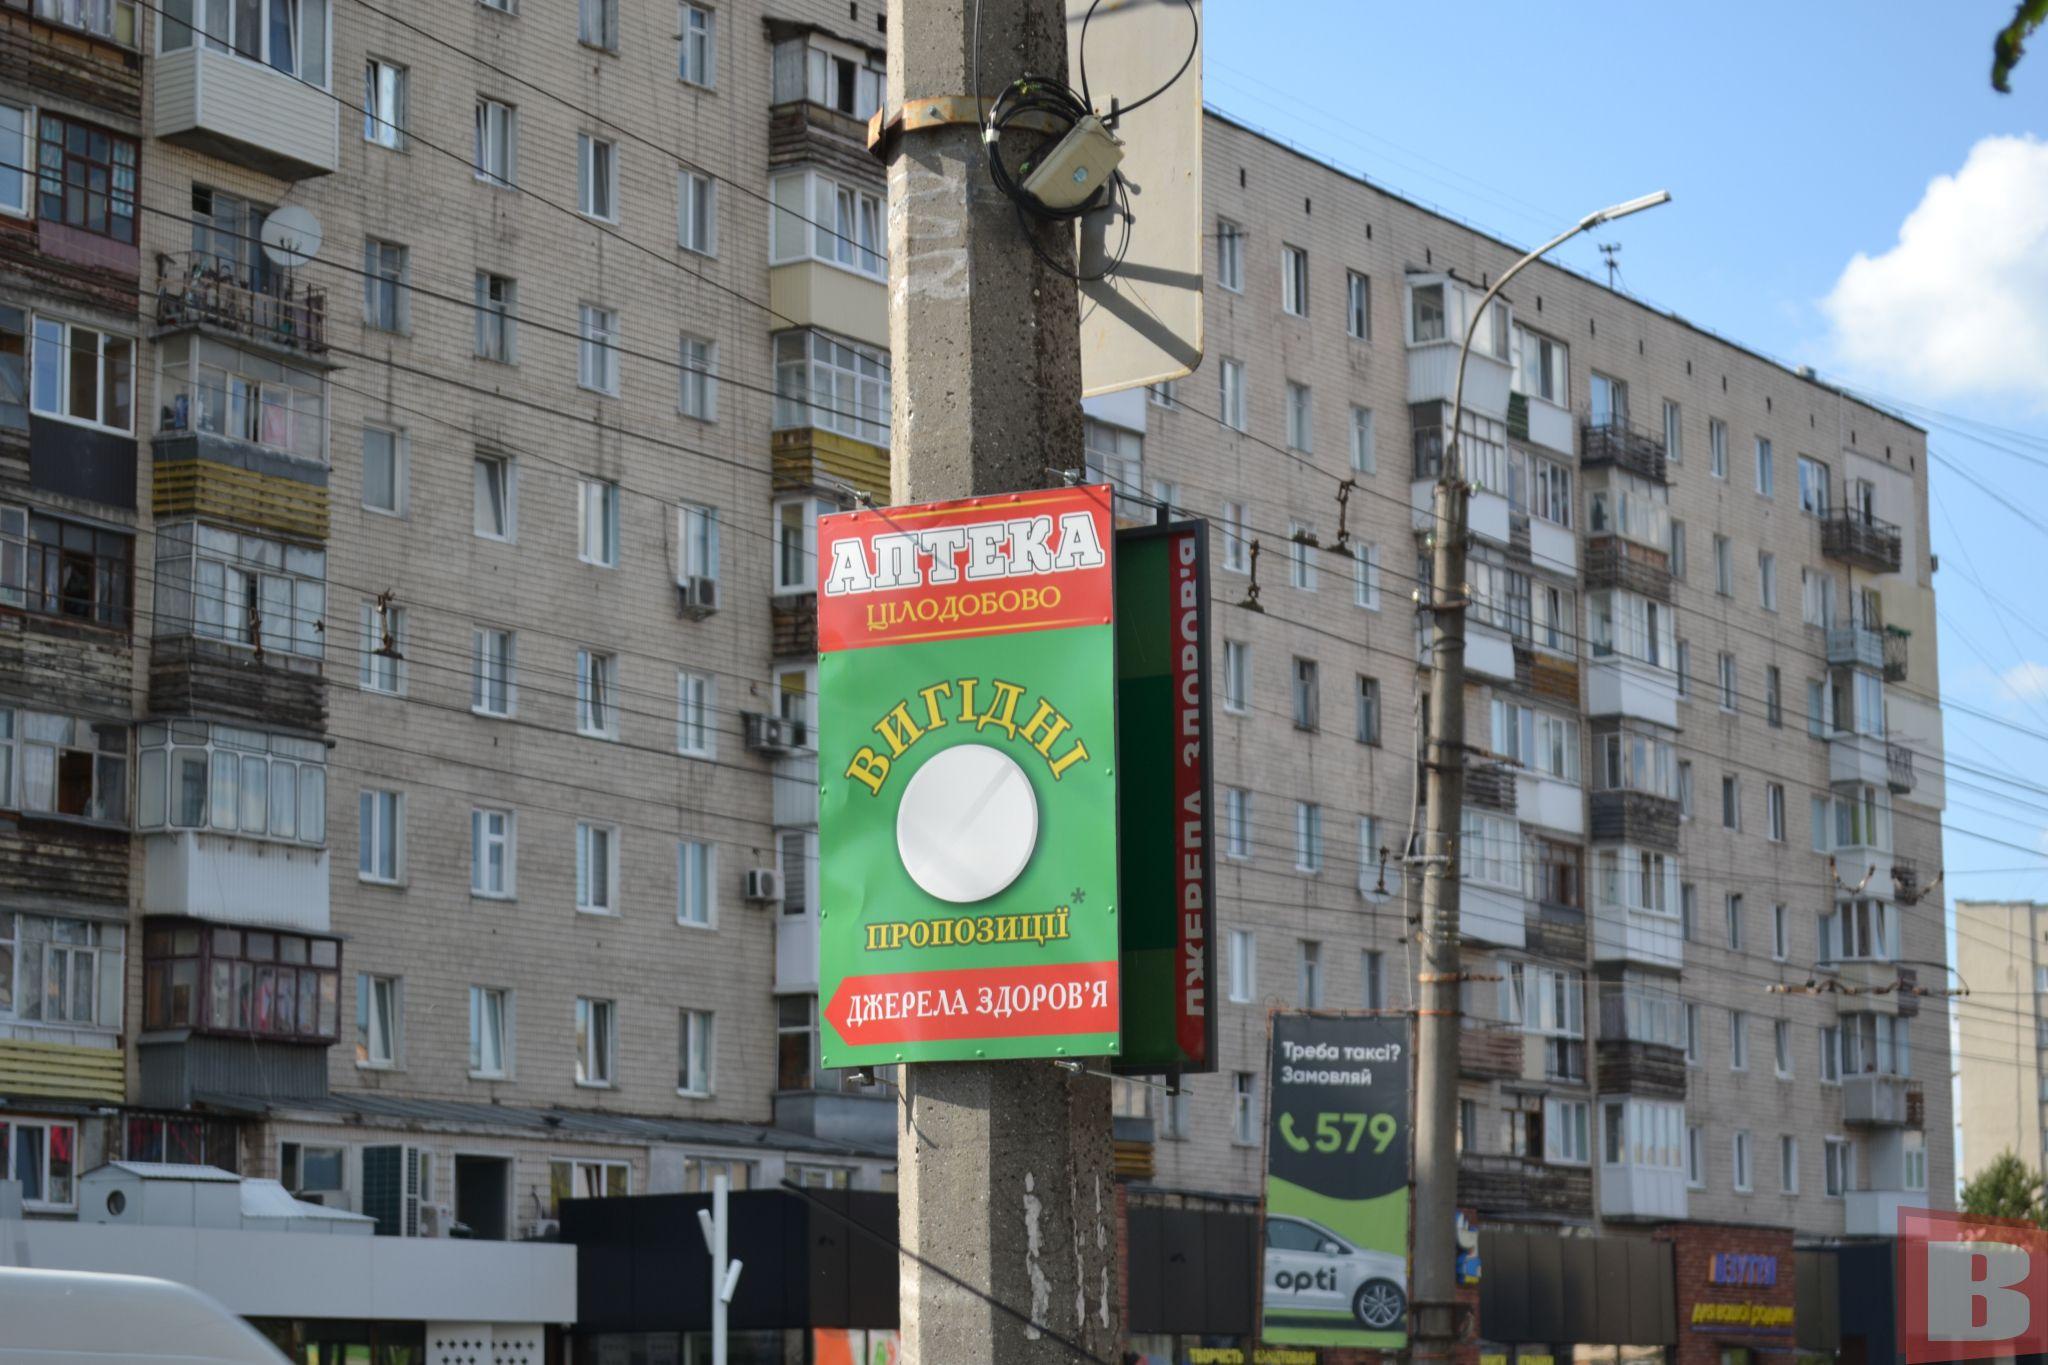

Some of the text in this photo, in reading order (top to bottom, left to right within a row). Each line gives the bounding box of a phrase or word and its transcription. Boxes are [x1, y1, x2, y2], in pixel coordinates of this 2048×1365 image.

[825, 511, 1106, 597] АПТЕКА
[866, 585, 1062, 632] ЦІЛОДОБОВО
[844, 677, 1091, 797] ВИГІДНІ
[846, 980, 1109, 1028] ДЖЕРЕЛА ЗДОРОВ'Я
[1282, 1040, 1402, 1063] Треба таксі?
[1281, 1065, 1373, 1086] Замовляй
[1315, 1112, 1398, 1154] 579
[1275, 1265, 1337, 1296] opti
